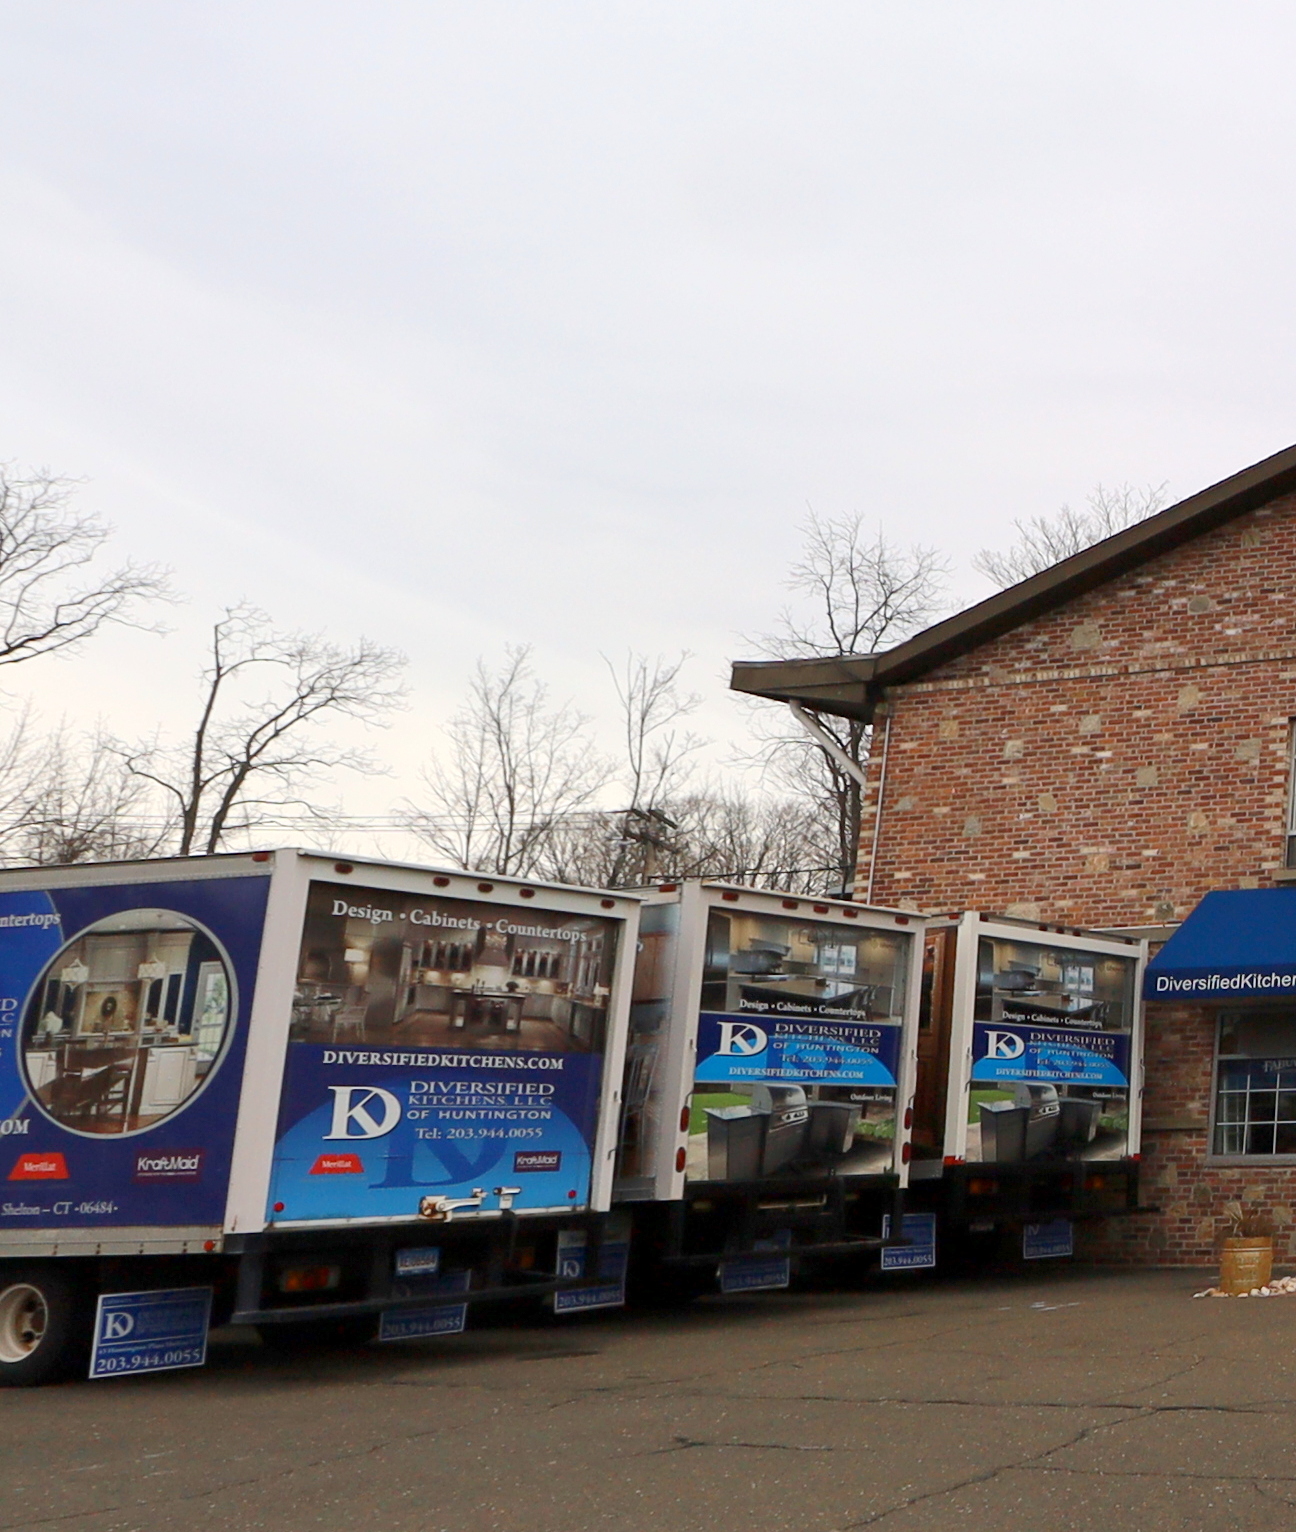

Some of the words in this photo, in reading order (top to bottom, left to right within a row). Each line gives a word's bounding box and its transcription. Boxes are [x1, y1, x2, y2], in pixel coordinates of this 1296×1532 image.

[332, 900, 393, 924] Design
[409, 908, 481, 930] Cabinets
[495, 919, 587, 944] Countertops
[739, 999, 769, 1011] Design
[776, 1003, 812, 1014] Cabinets
[819, 1005, 866, 1018] Countertops
[775, 1023, 881, 1038] DIVERSIFIED
[1030, 1032, 1115, 1046] DIVERSIFIED
[773, 1042, 790, 1050] OF
[796, 1042, 879, 1054] HUNTINGTON
[322, 1050, 564, 1070] DIVERSIFIEDKITCHENS.COM
[729, 1066, 864, 1079] DIVERSIFIEDKITCHENS.COM
[409, 1081, 555, 1096] DIVERSIFIED
[406, 1109, 430, 1120] OF
[438, 1109, 552, 1120] HUNTINGTON
[415, 1128, 442, 1139] Tel:
[446, 1127, 543, 1139] 203.944.0055
[53, 1202, 72, 1215] CT
[97, 1349, 200, 1372] 203.944.0055
